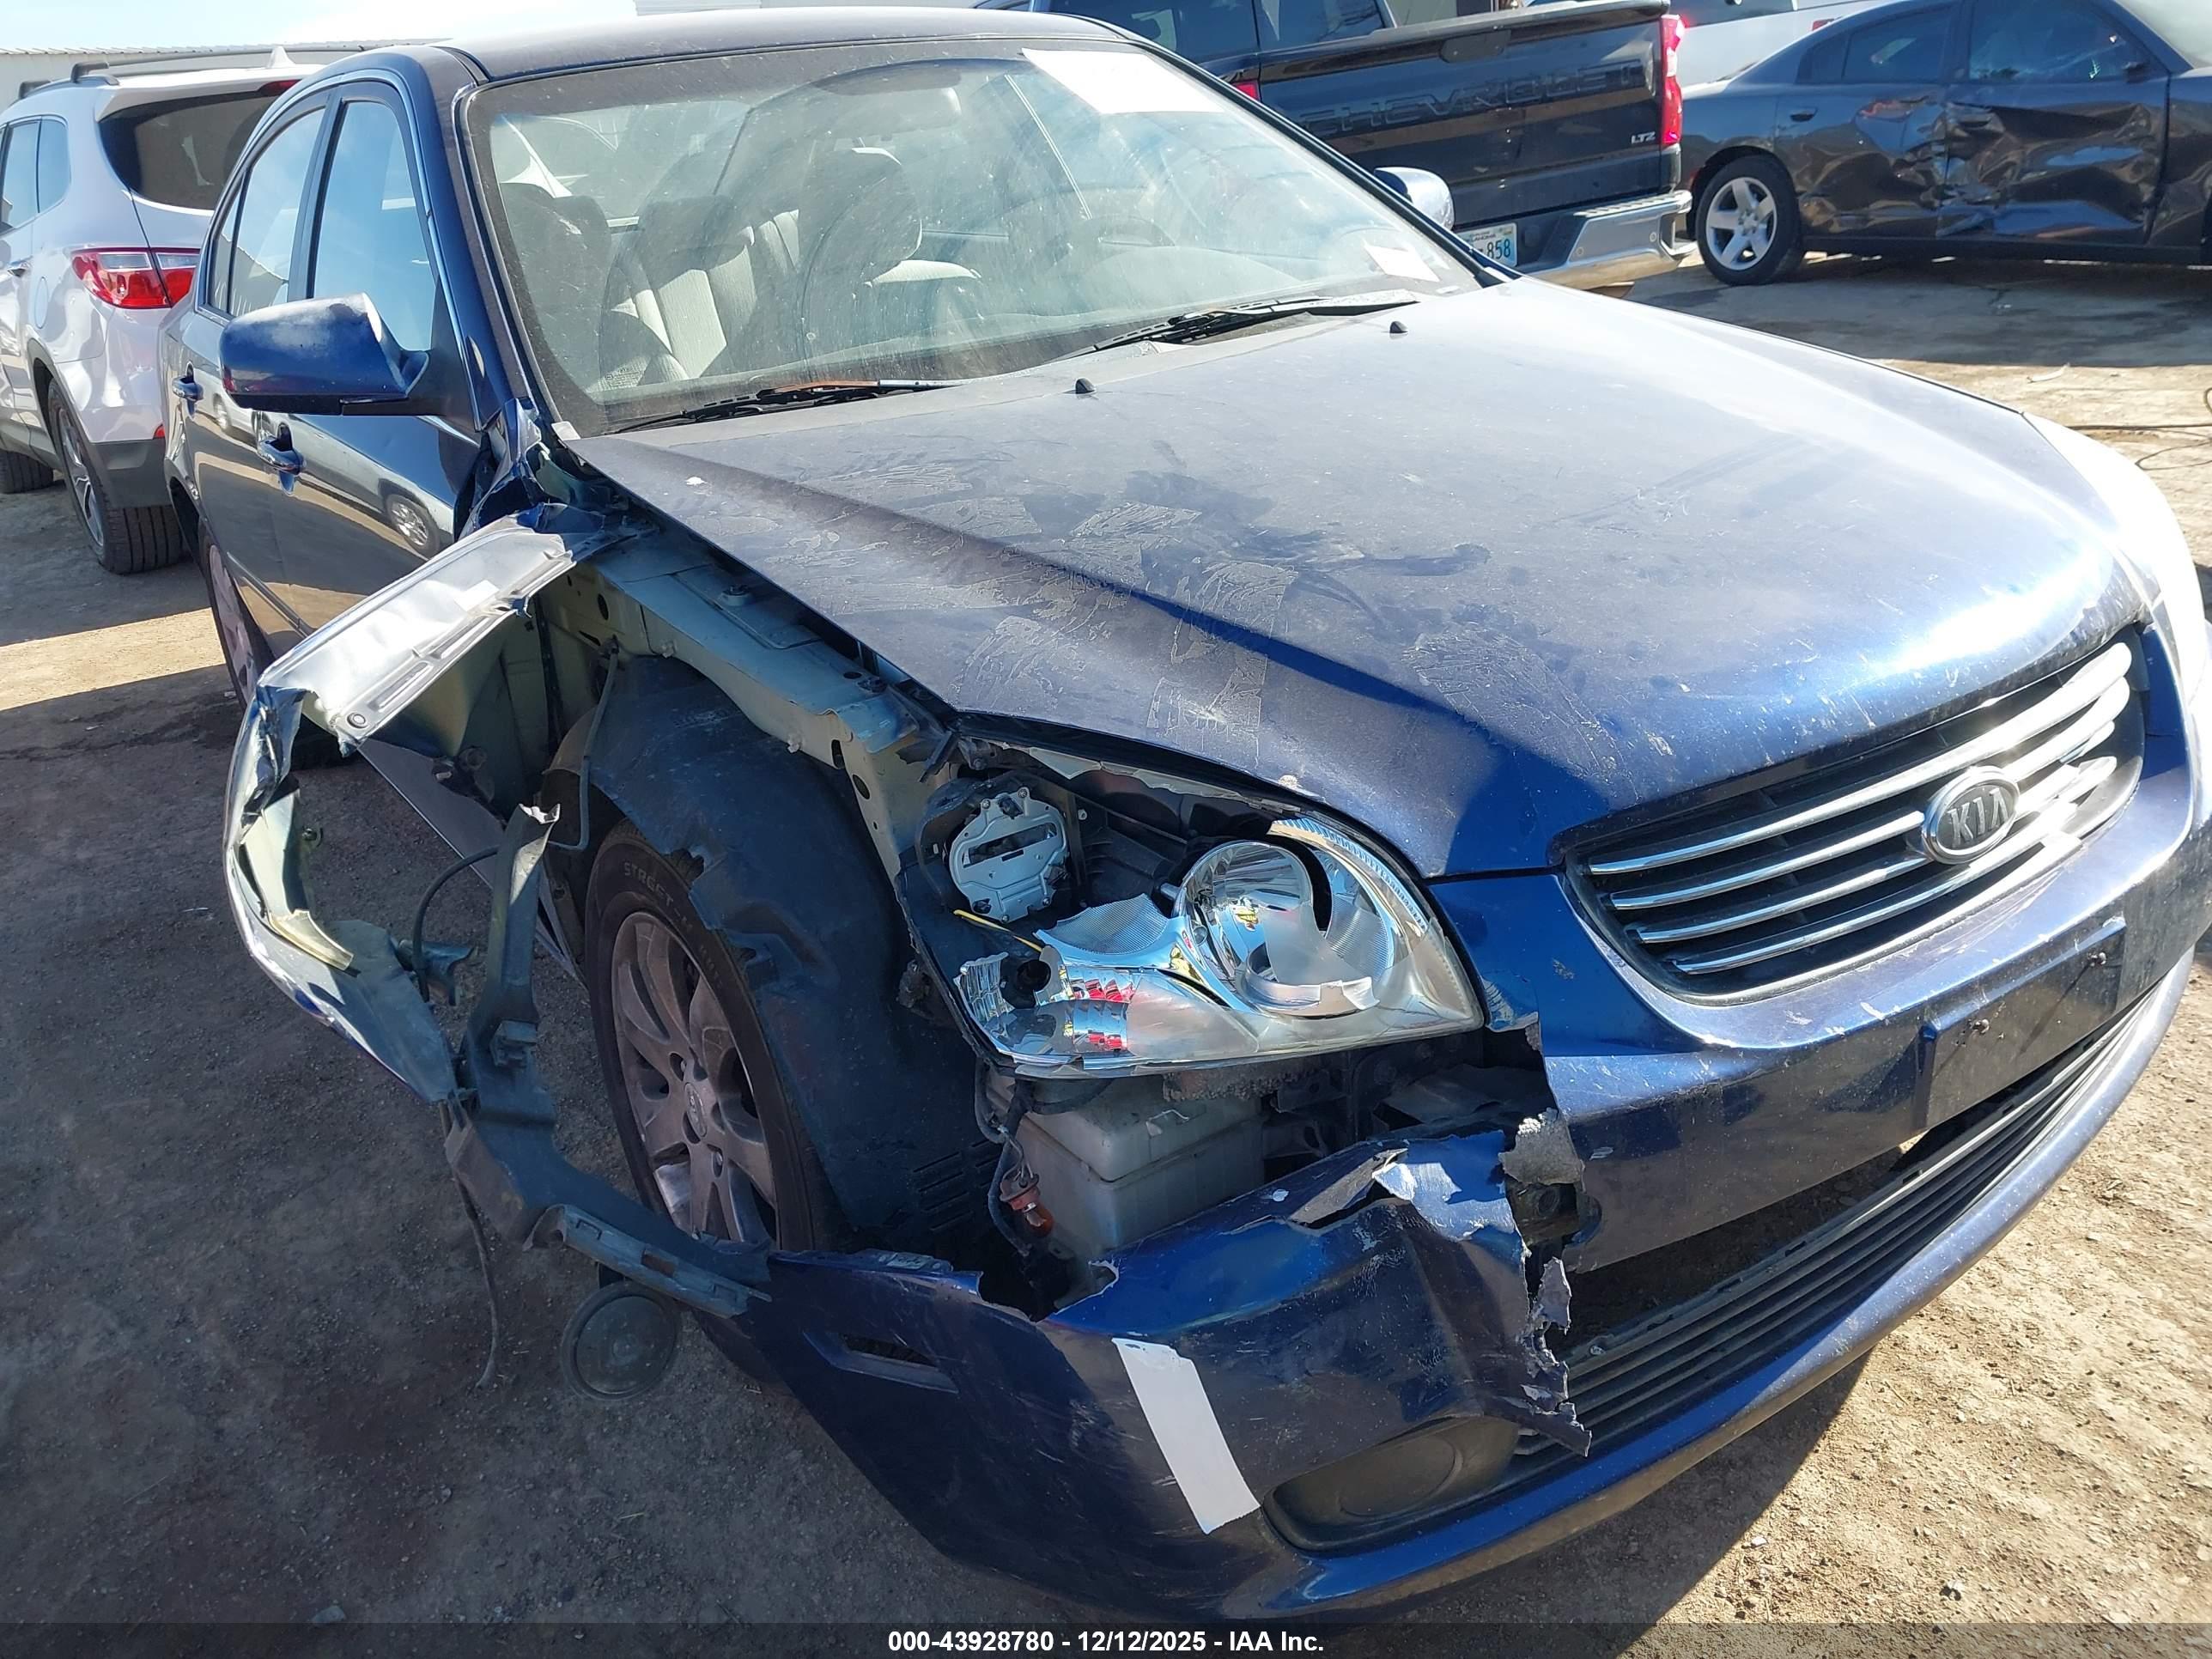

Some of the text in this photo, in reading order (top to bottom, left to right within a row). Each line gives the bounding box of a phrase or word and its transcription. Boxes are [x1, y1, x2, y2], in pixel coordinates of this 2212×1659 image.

[1299, 58, 1644, 137] CHEVROLET
[1631, 131, 1656, 145] LTZ
[1947, 787, 2009, 848] KIA
